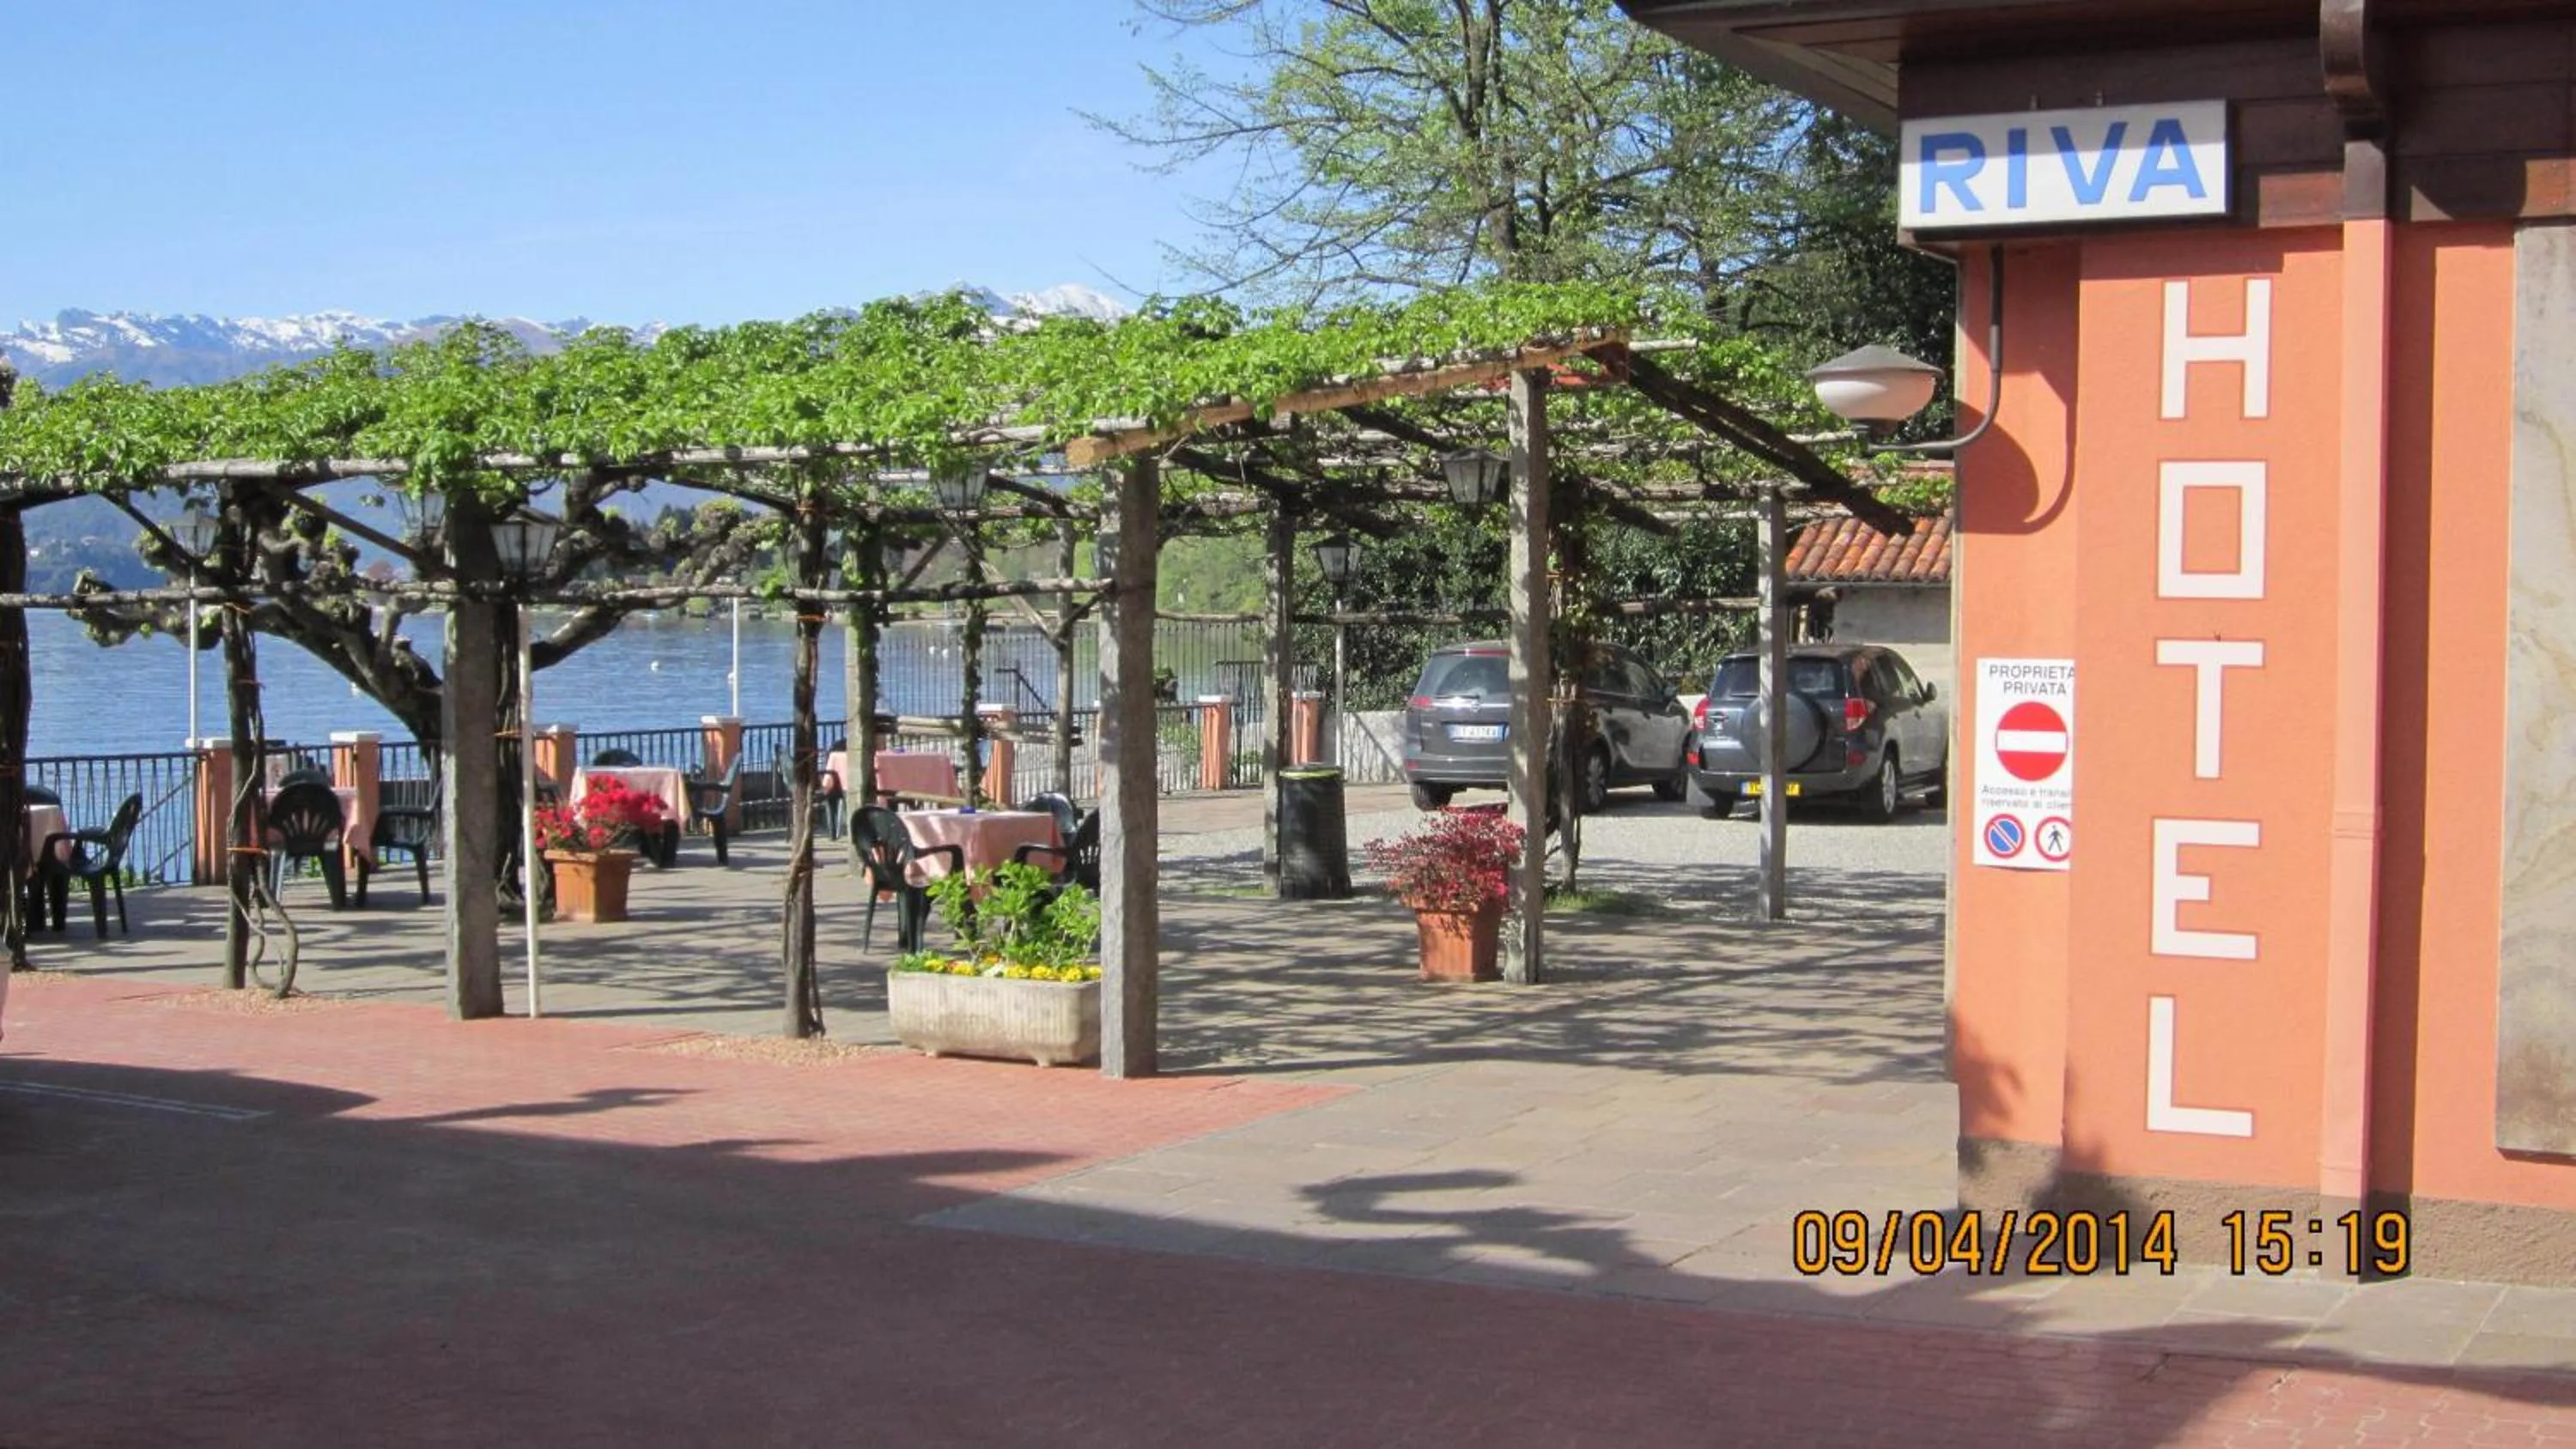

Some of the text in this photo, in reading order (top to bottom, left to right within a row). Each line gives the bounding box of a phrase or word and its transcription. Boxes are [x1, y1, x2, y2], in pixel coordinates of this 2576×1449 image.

[1919, 118, 2207, 214] RIVA
[2002, 680, 2067, 694] PRIVATA
[2145, 278, 2273, 1137] HOTEL
